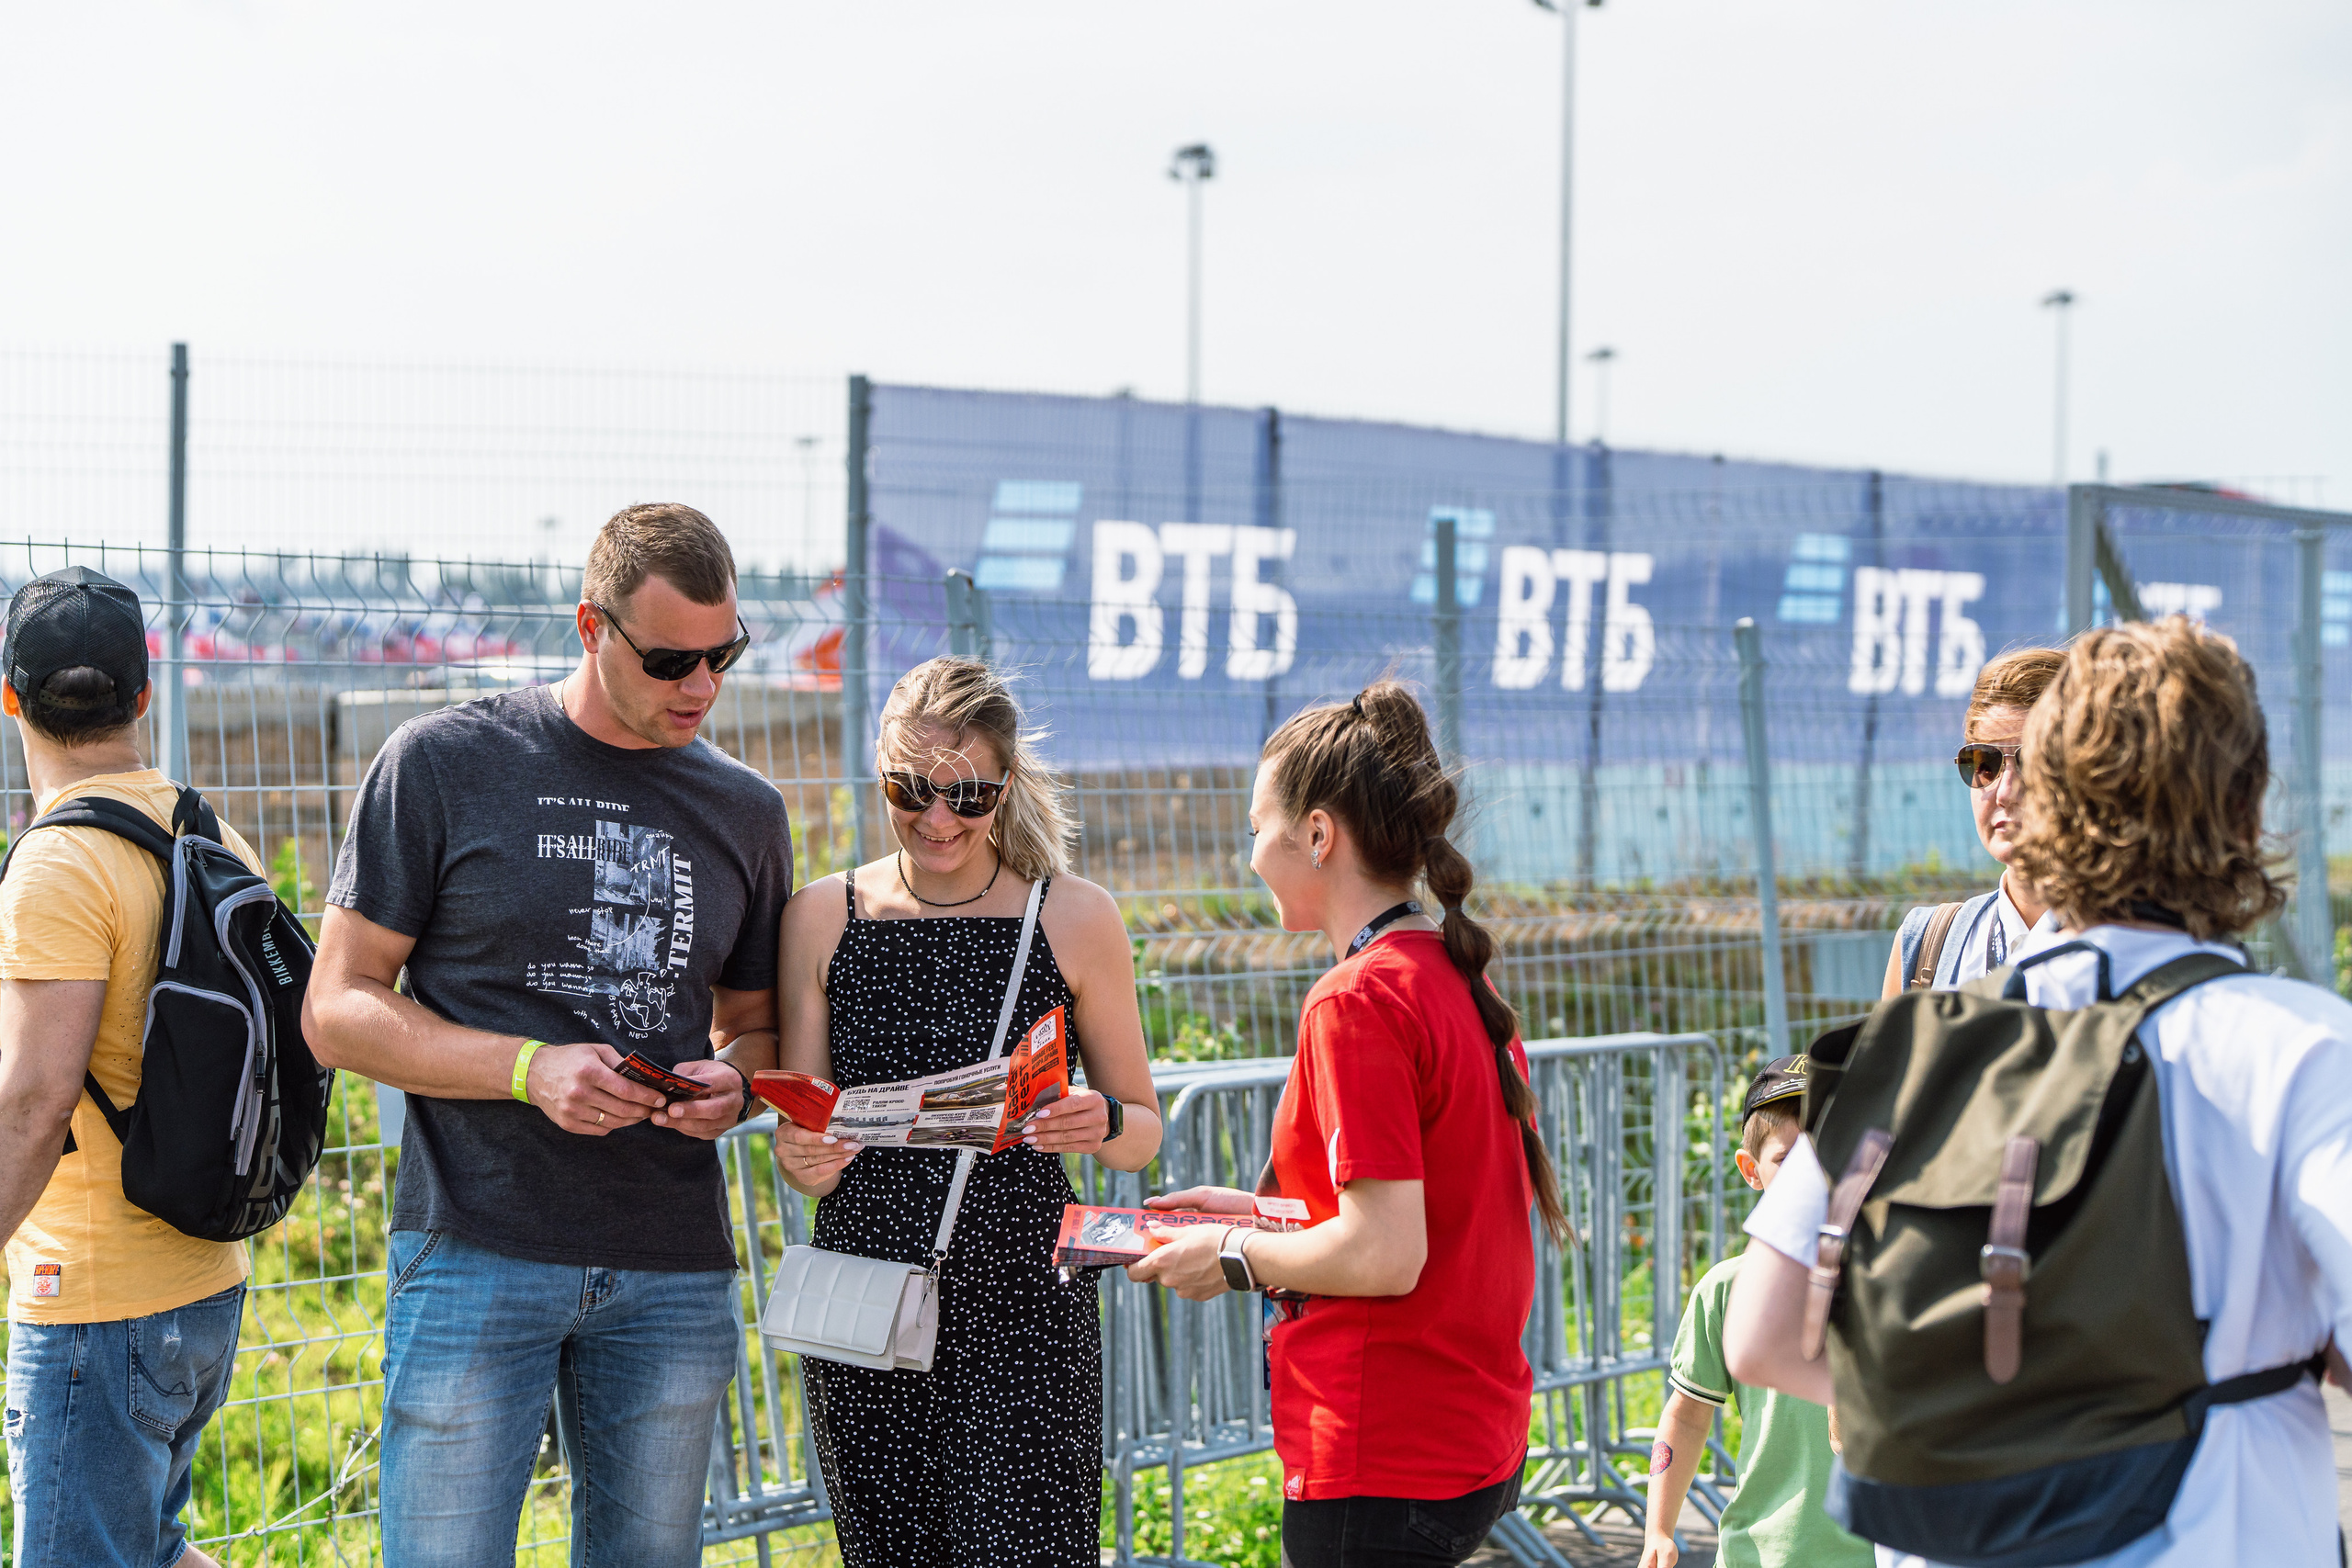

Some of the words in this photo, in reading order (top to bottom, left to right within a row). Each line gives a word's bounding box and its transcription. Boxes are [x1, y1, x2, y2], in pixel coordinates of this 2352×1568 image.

[1088, 520, 1298, 681] ВТБ
[1492, 546, 1656, 692] ВТБ
[1848, 566, 1987, 698] ВТБ
[597, 907, 613, 915] stop
[667, 853, 694, 970] TERMIT
[541, 963, 556, 971] you
[541, 972, 554, 982] you
[542, 981, 556, 990] you
[628, 1031, 649, 1039] NEW
[933, 1075, 958, 1085] ПОПРОБУЙ
[983, 1064, 1001, 1074] УСЛУГИ
[847, 1087, 867, 1096] БУДЬ
[878, 1083, 910, 1093] ДРАЙВЕ
